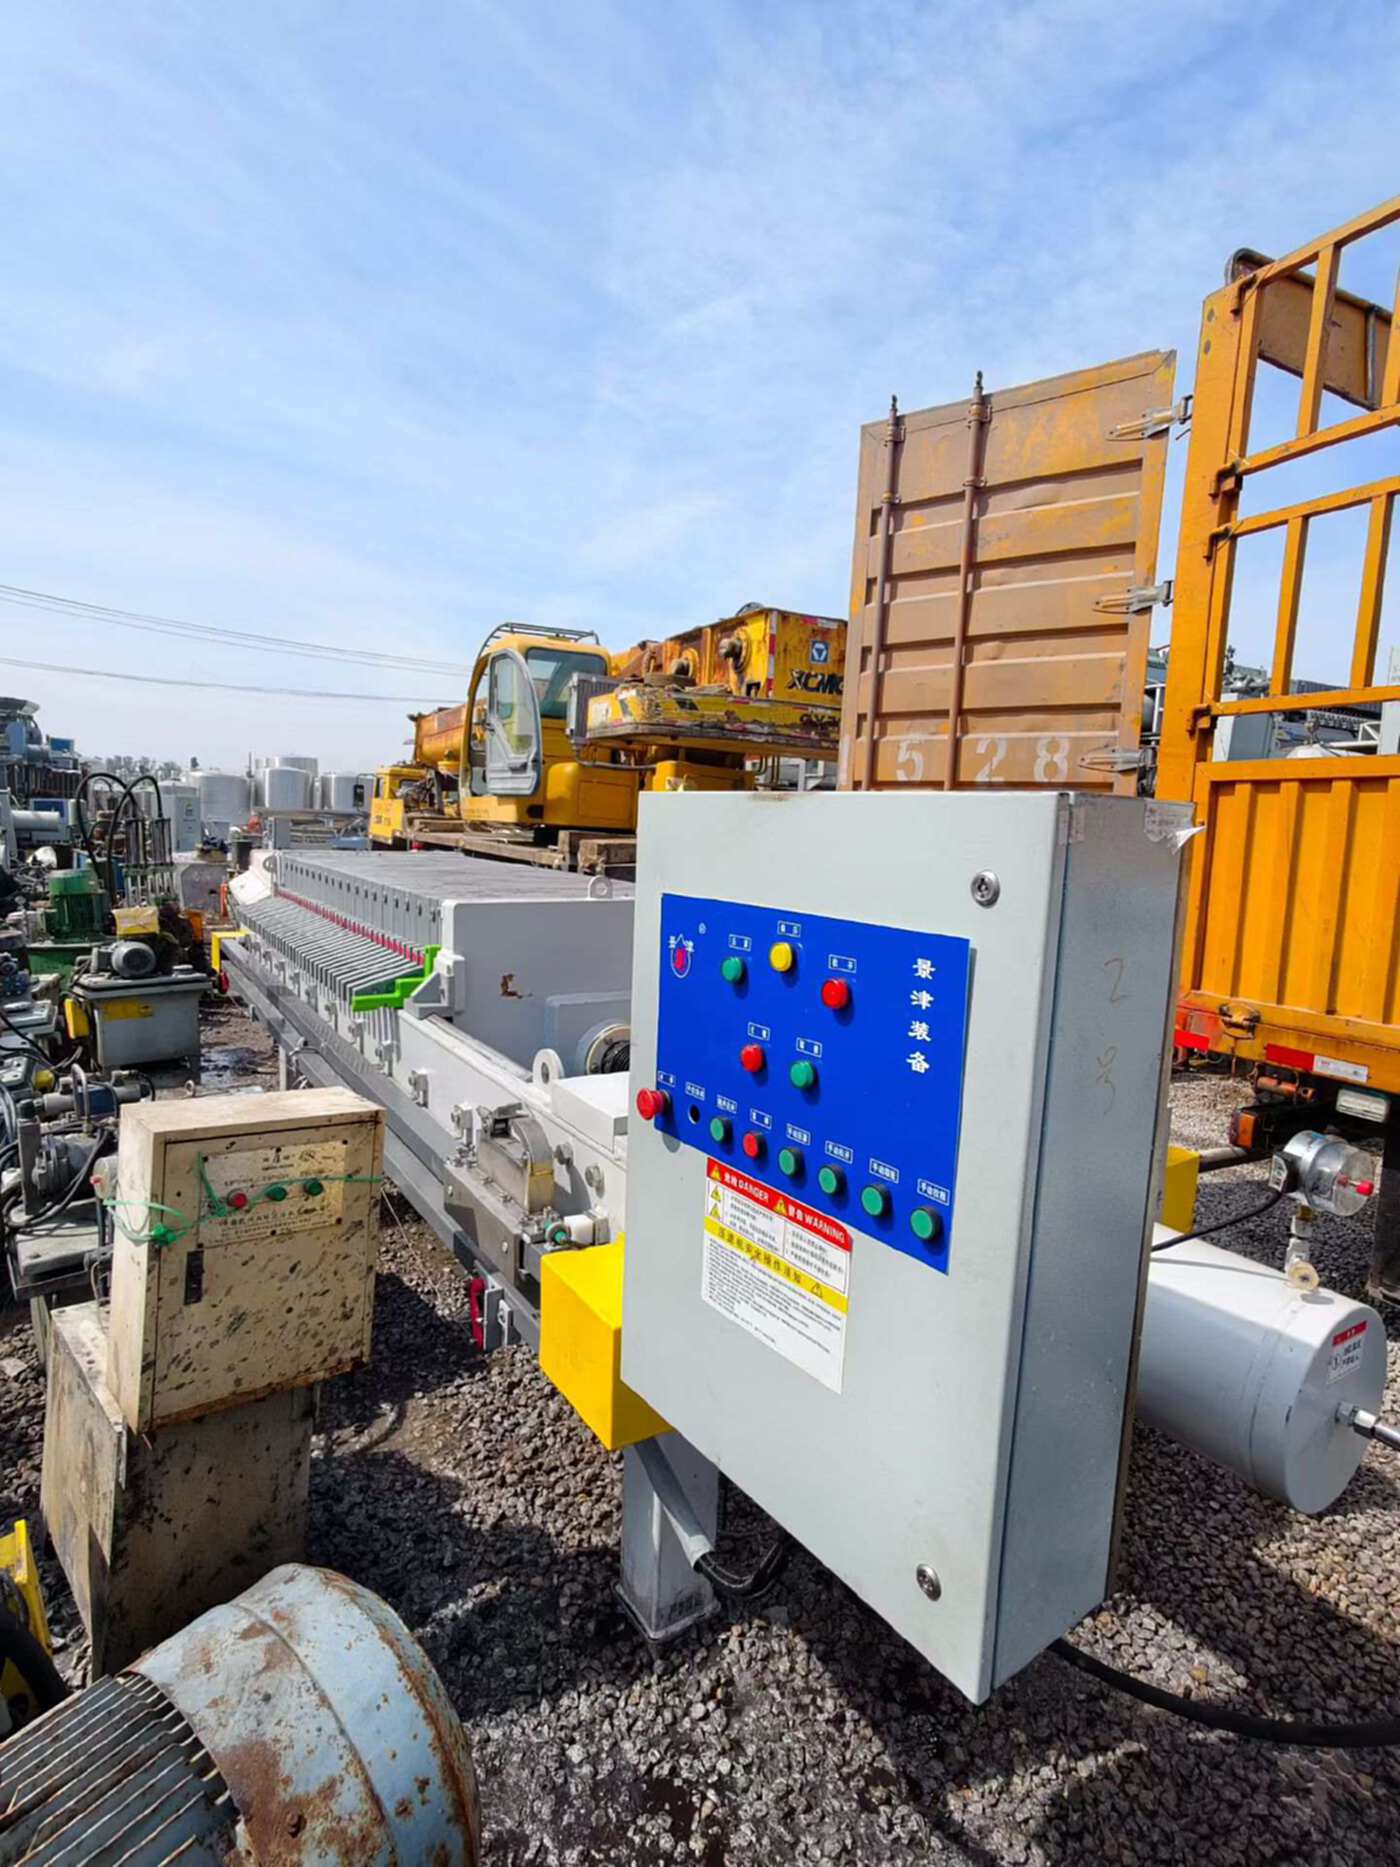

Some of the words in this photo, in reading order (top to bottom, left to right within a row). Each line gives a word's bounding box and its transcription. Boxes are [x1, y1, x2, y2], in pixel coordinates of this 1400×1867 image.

[905, 957, 937, 1074] 景津装备
[738, 1178, 770, 1202] DANGER
[804, 1212, 846, 1243] WARNING
